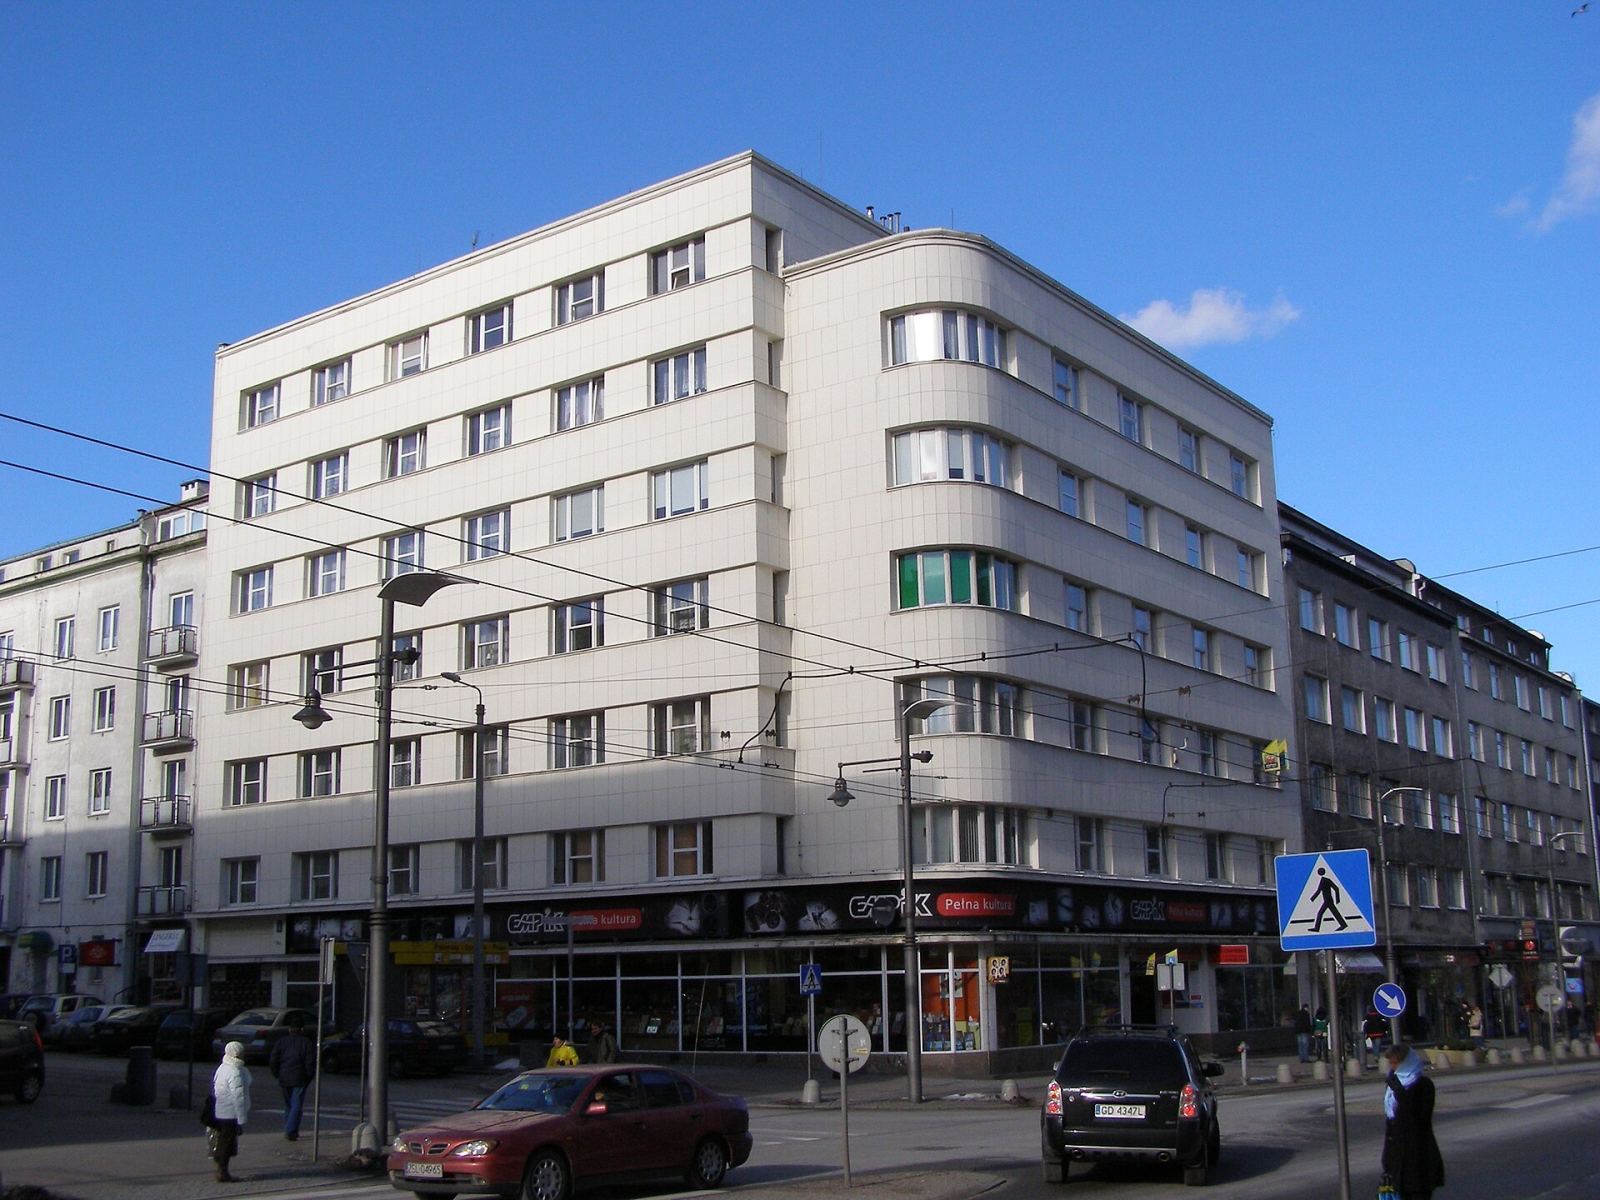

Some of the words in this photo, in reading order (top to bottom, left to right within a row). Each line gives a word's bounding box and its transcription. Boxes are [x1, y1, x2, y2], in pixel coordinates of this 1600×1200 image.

[945, 898, 979, 910] Pełna
[983, 898, 1012, 911] kultura
[601, 913, 636, 925] kultura
[62, 946, 73, 962] P
[1101, 1106, 1114, 1115] GD
[1117, 1106, 1143, 1116] 4347L
